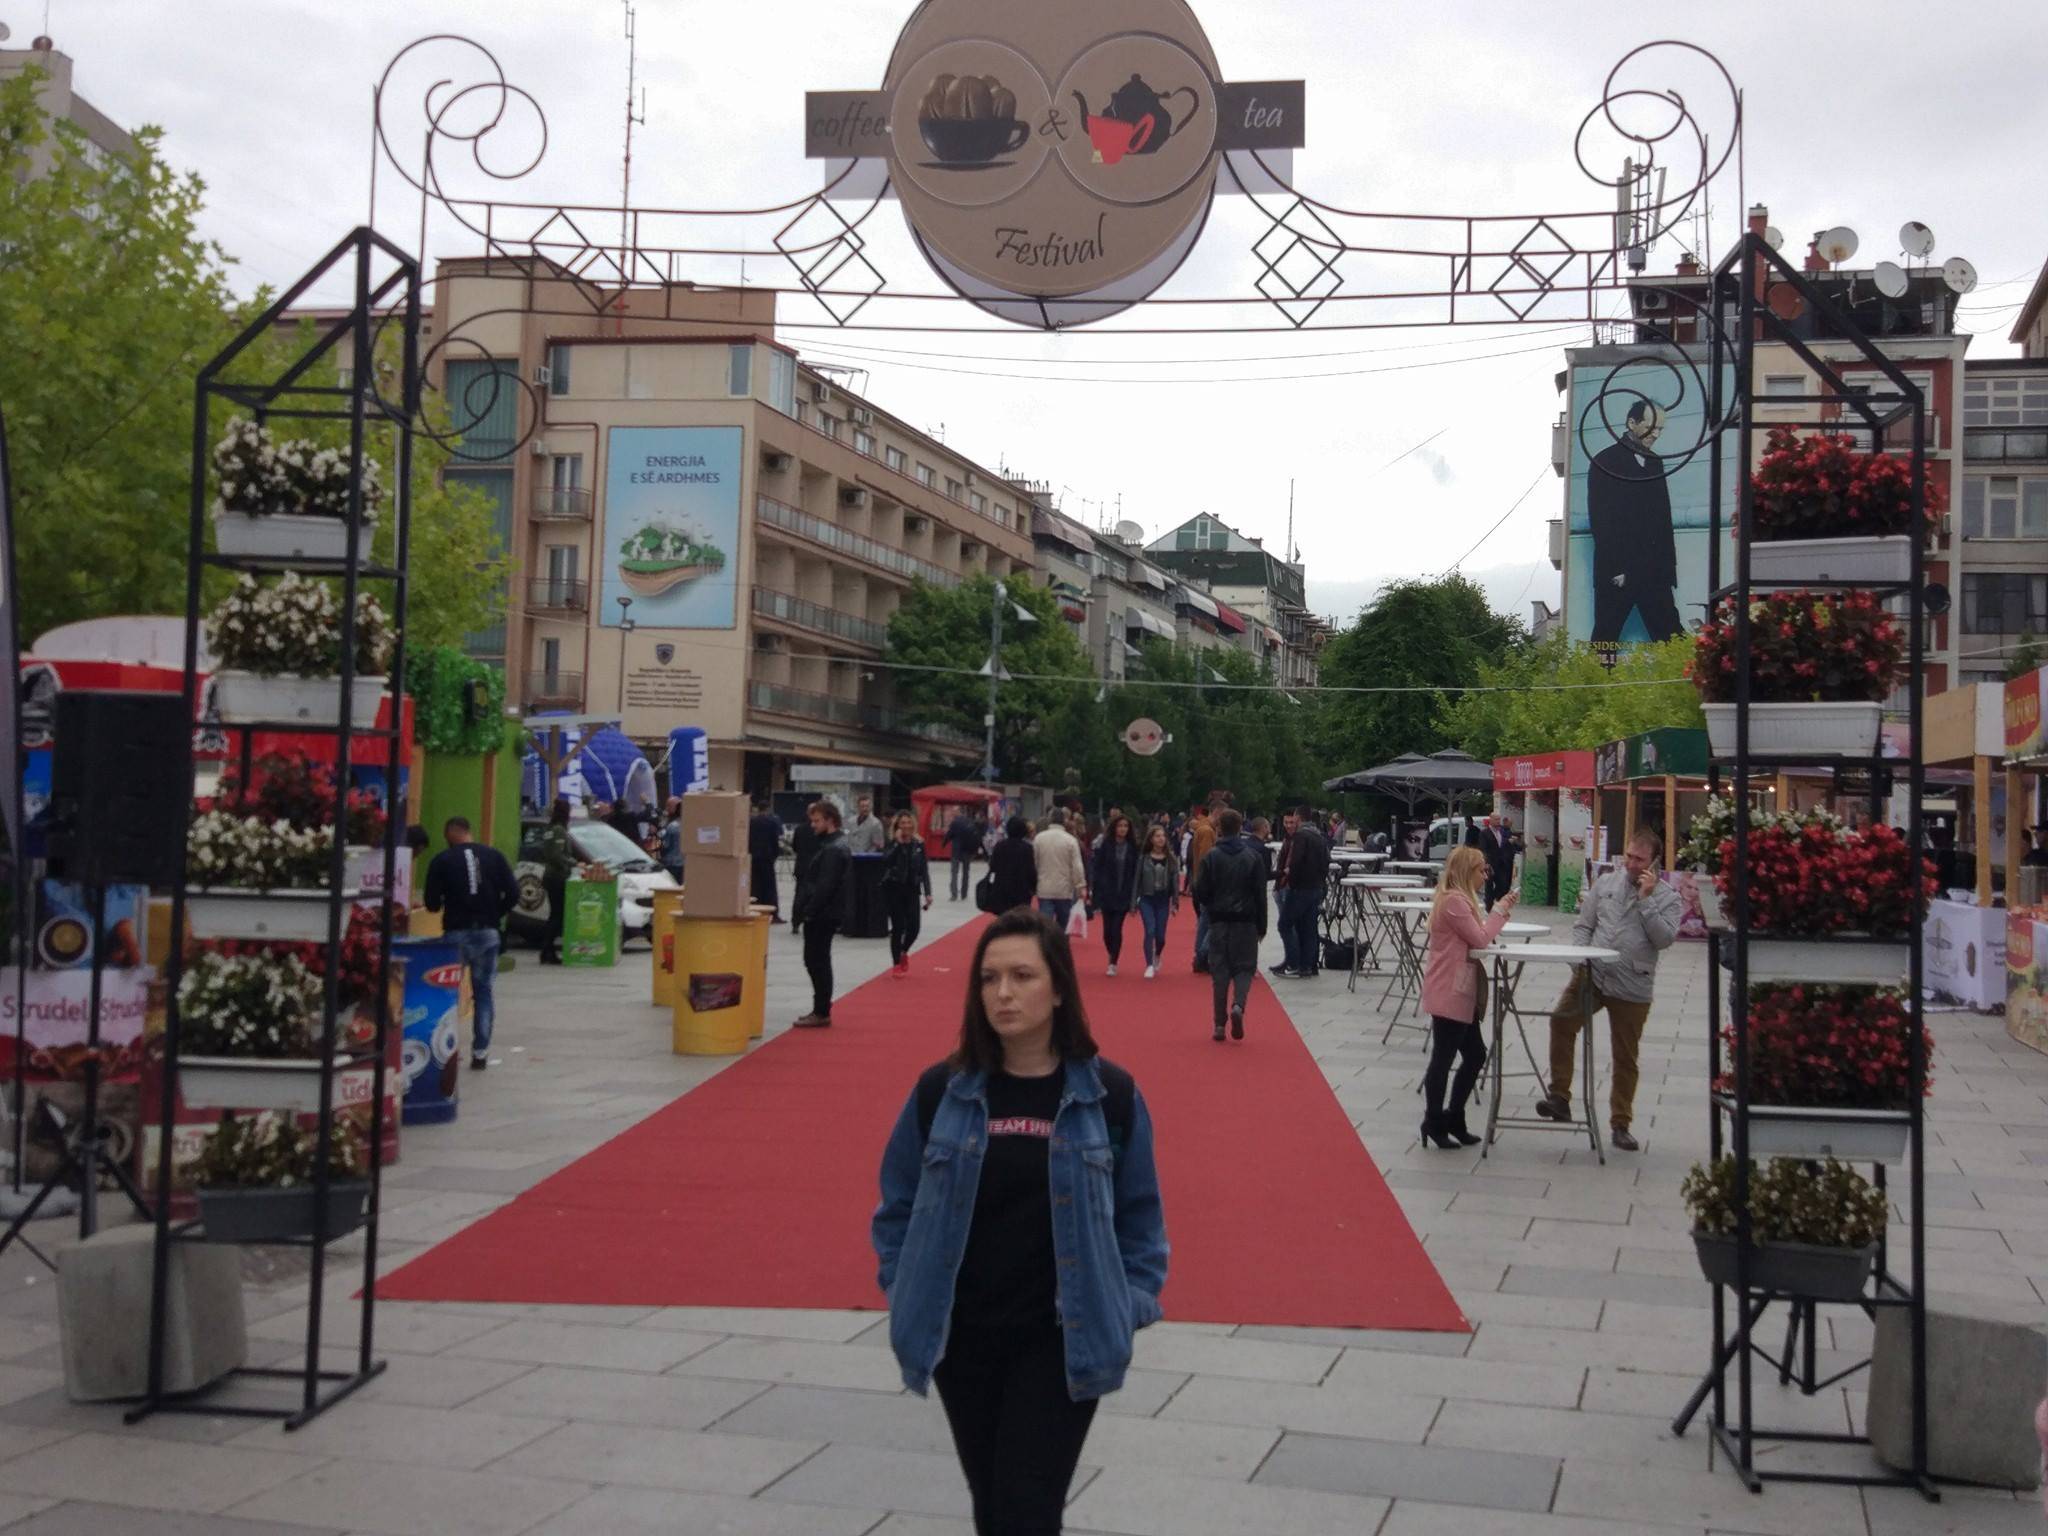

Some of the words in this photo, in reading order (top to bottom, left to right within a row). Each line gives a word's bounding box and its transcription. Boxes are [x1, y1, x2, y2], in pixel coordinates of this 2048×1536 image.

[811, 101, 888, 146] coffee
[1038, 109, 1070, 141] &
[1243, 97, 1283, 129] tea
[994, 211, 1108, 268] Festival
[646, 455, 706, 467] ENERGJIA
[630, 472, 639, 484] E
[656, 472, 720, 484] ARDHMES
[3, 994, 90, 1021] Srudel
